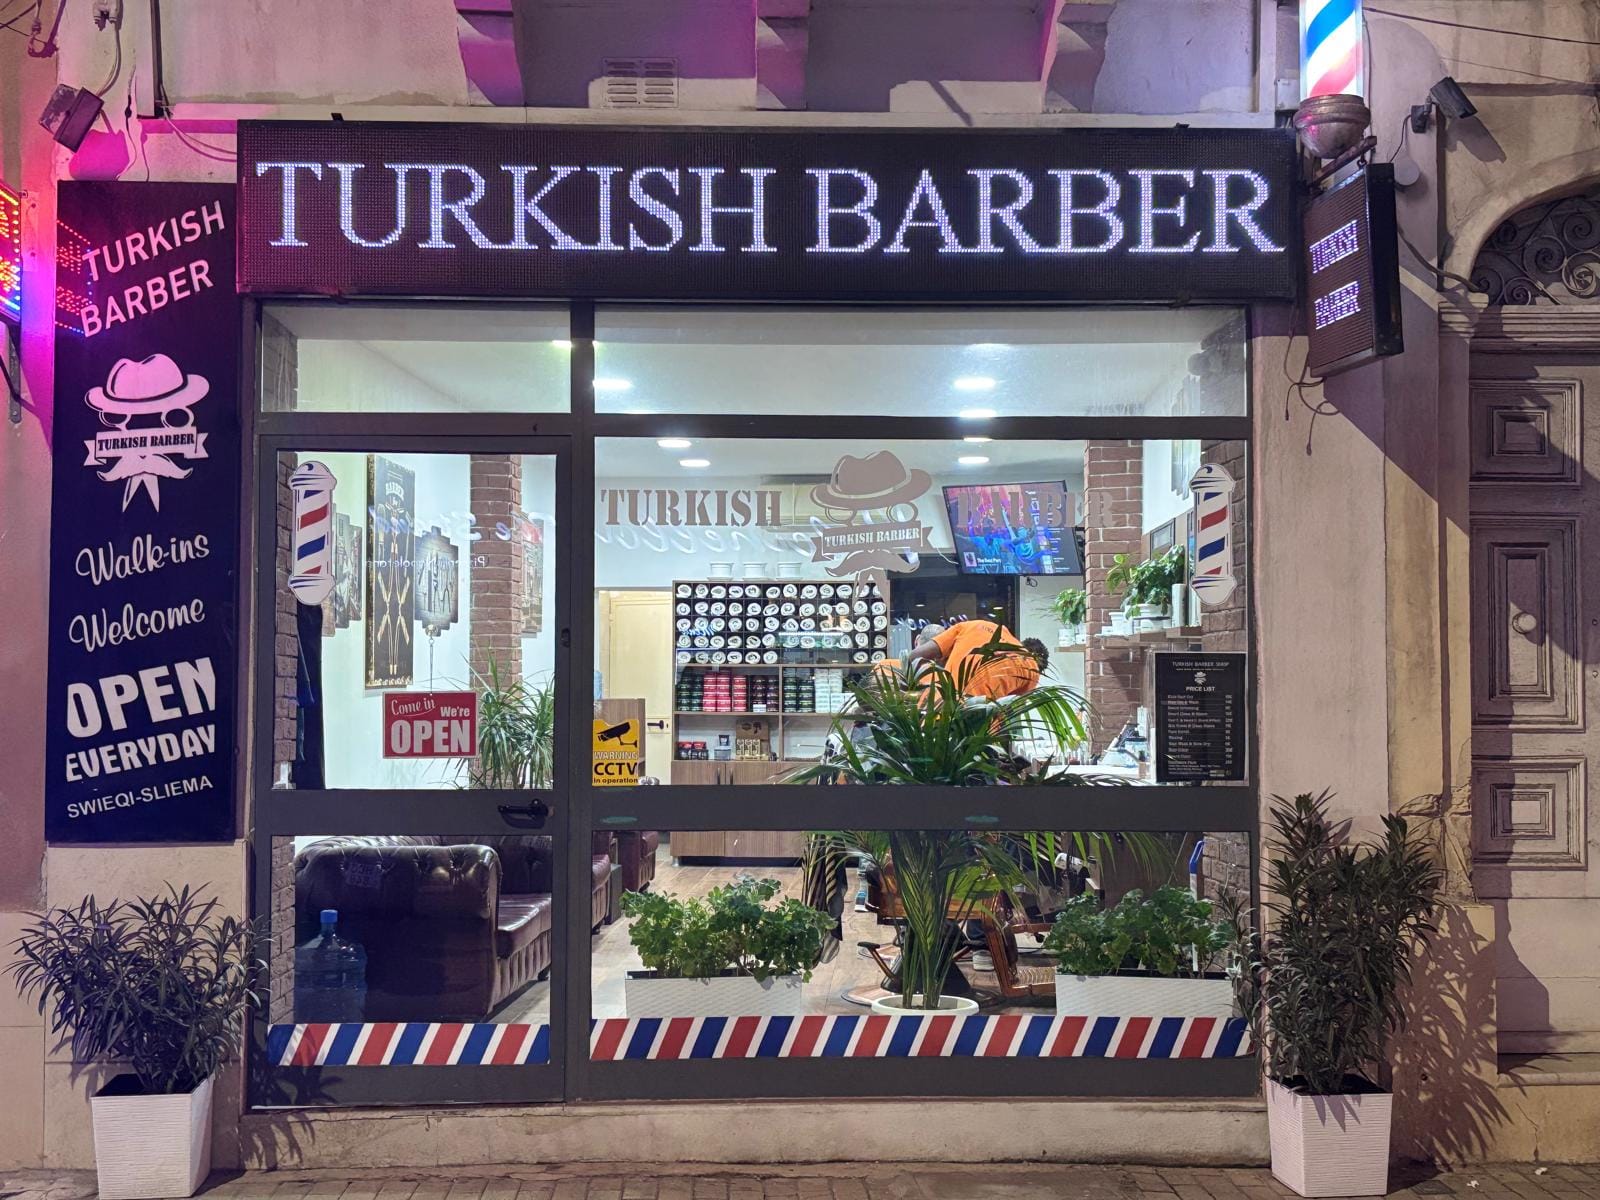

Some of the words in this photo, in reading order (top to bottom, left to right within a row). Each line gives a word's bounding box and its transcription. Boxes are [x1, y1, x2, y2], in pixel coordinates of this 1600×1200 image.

[255, 161, 777, 252] TURKISH
[805, 168, 1286, 254] BARBER
[82, 200, 225, 281] TURKISH
[80, 259, 214, 338] BARBER
[98, 437, 147, 451] TURKISH
[150, 433, 195, 447] BARBER
[600, 489, 782, 526] TURKISH
[825, 532, 873, 547] TURKISH
[876, 527, 919, 542] BARBER
[75, 534, 209, 586] Walk-ins
[69, 598, 205, 652] Welcome
[67, 657, 216, 738] OPEN
[391, 699, 421, 716] Come
[423, 697, 436, 710] in
[440, 706, 470, 717] We're
[66, 724, 216, 782] EVERYDAY
[391, 719, 470, 754] OPEN
[594, 751, 638, 760] WARNING
[594, 762, 637, 776] CCTV
[67, 775, 213, 818] SWIEQI-SLIEMA
